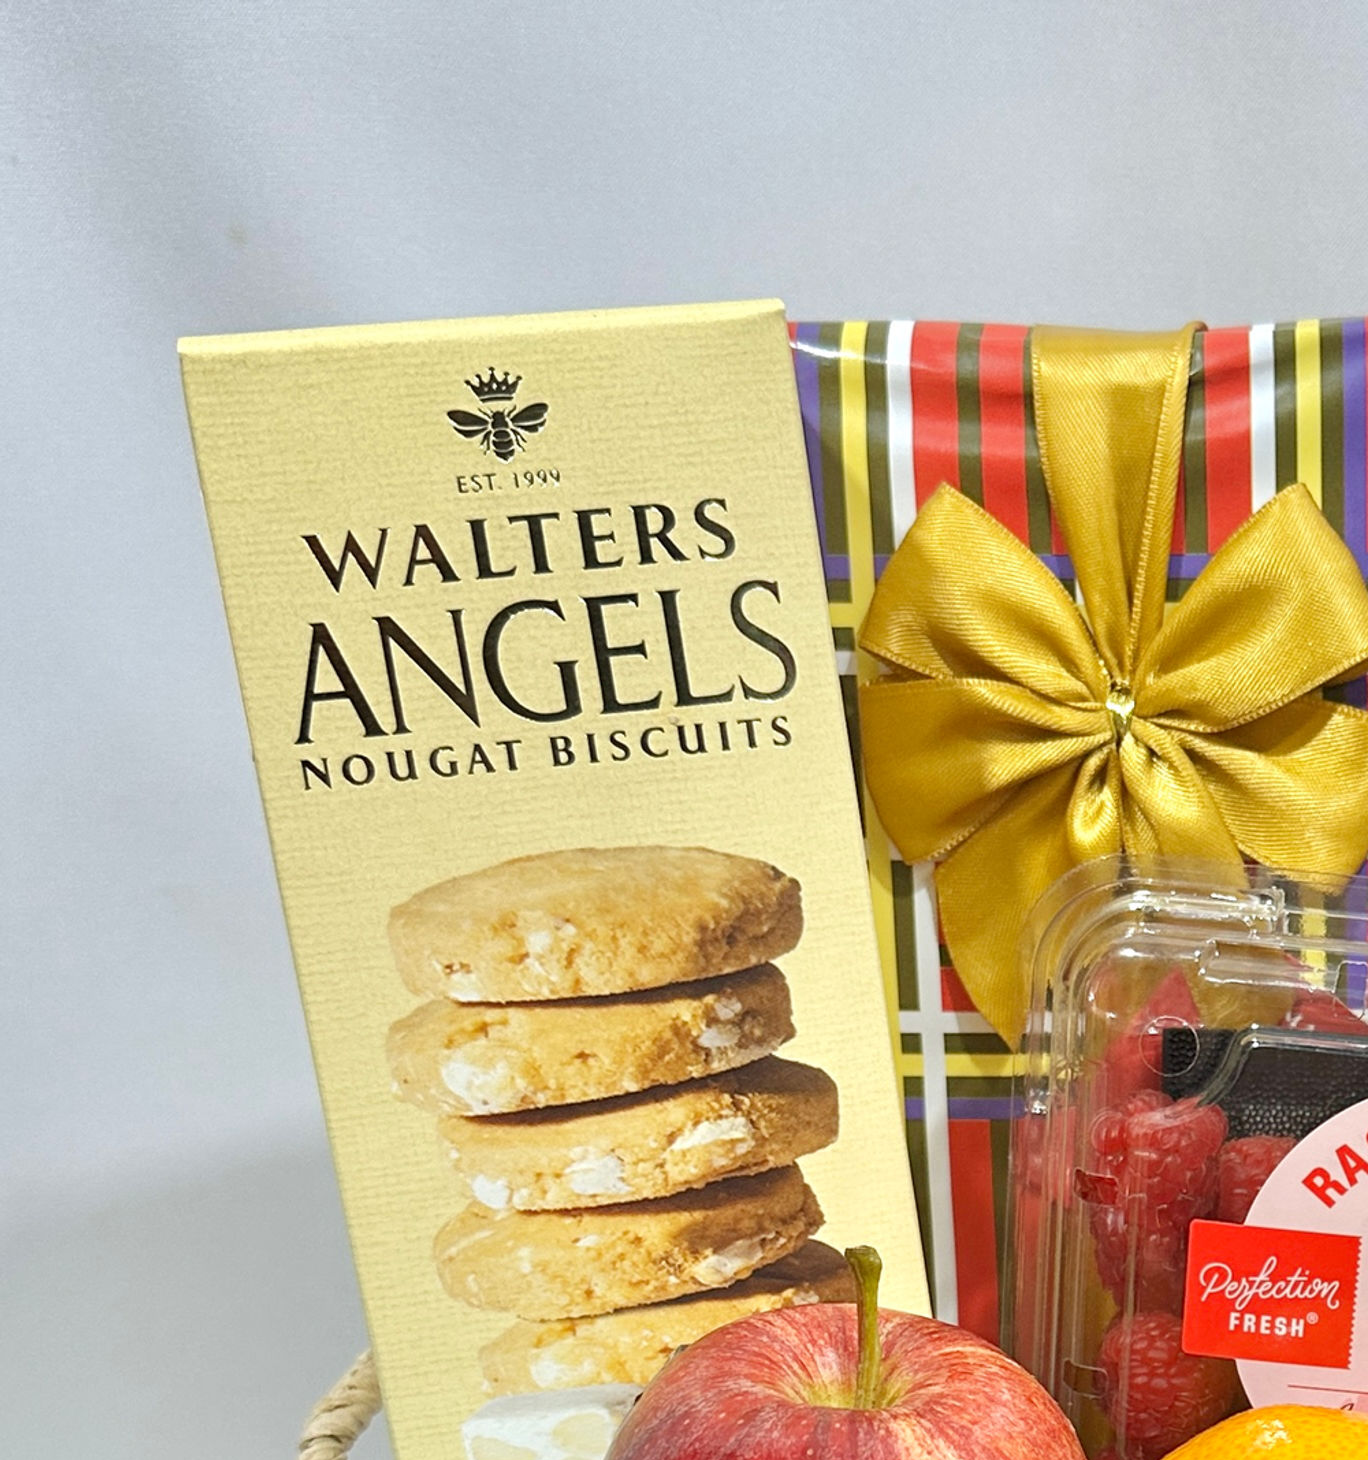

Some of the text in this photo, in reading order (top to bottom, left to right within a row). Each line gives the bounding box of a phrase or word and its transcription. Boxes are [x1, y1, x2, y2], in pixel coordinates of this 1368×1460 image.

[456, 474, 503, 493] EST.
[301, 498, 736, 593] WALTERS
[294, 580, 797, 744] ANGELS
[300, 716, 792, 790] NOUGAT BISCUITS
[1199, 1256, 1340, 1310] Perfection
